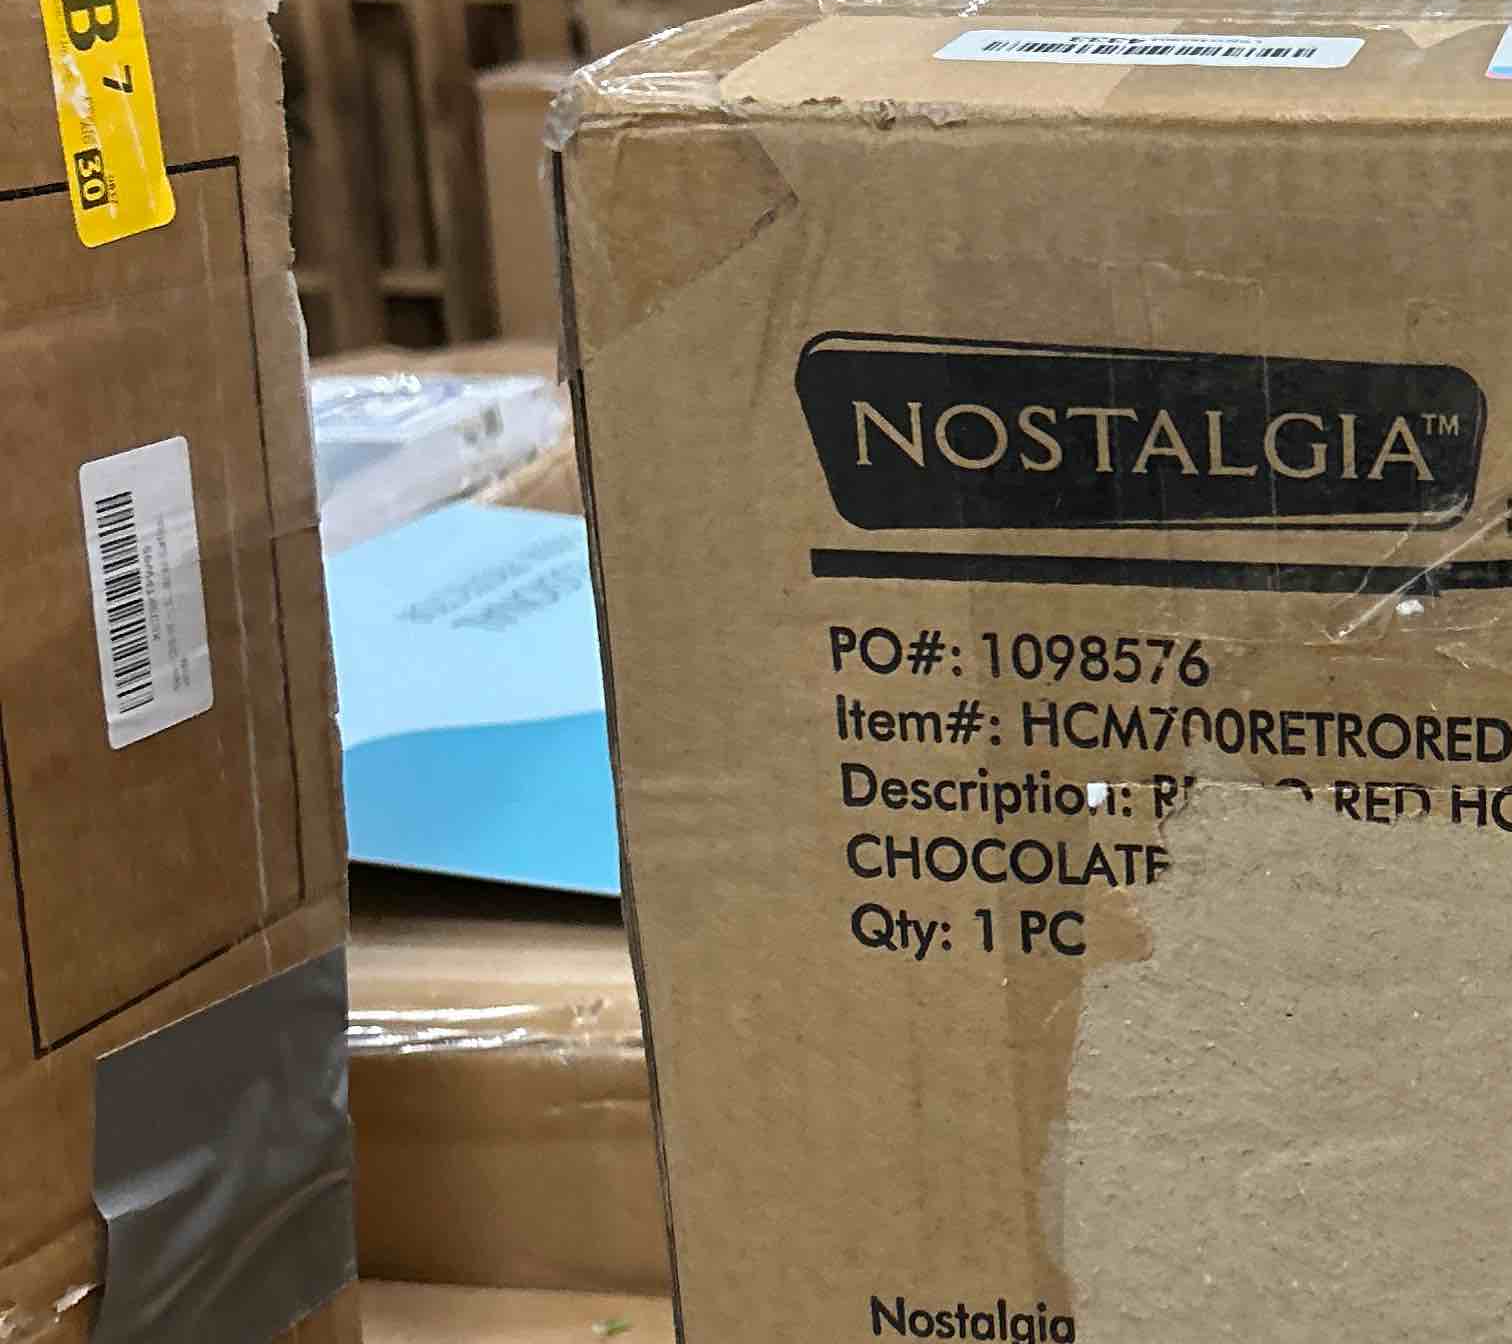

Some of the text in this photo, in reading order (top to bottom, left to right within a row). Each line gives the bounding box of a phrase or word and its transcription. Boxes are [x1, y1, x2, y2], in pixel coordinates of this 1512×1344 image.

[102, 64, 134, 93] 7
[76, 154, 107, 205] 30
[828, 625, 1211, 688] PO#: 1098576
[835, 692, 1002, 747] Item#:
[1334, 780, 1432, 826] RED
[850, 902, 1087, 961] Qty: 1 PC
